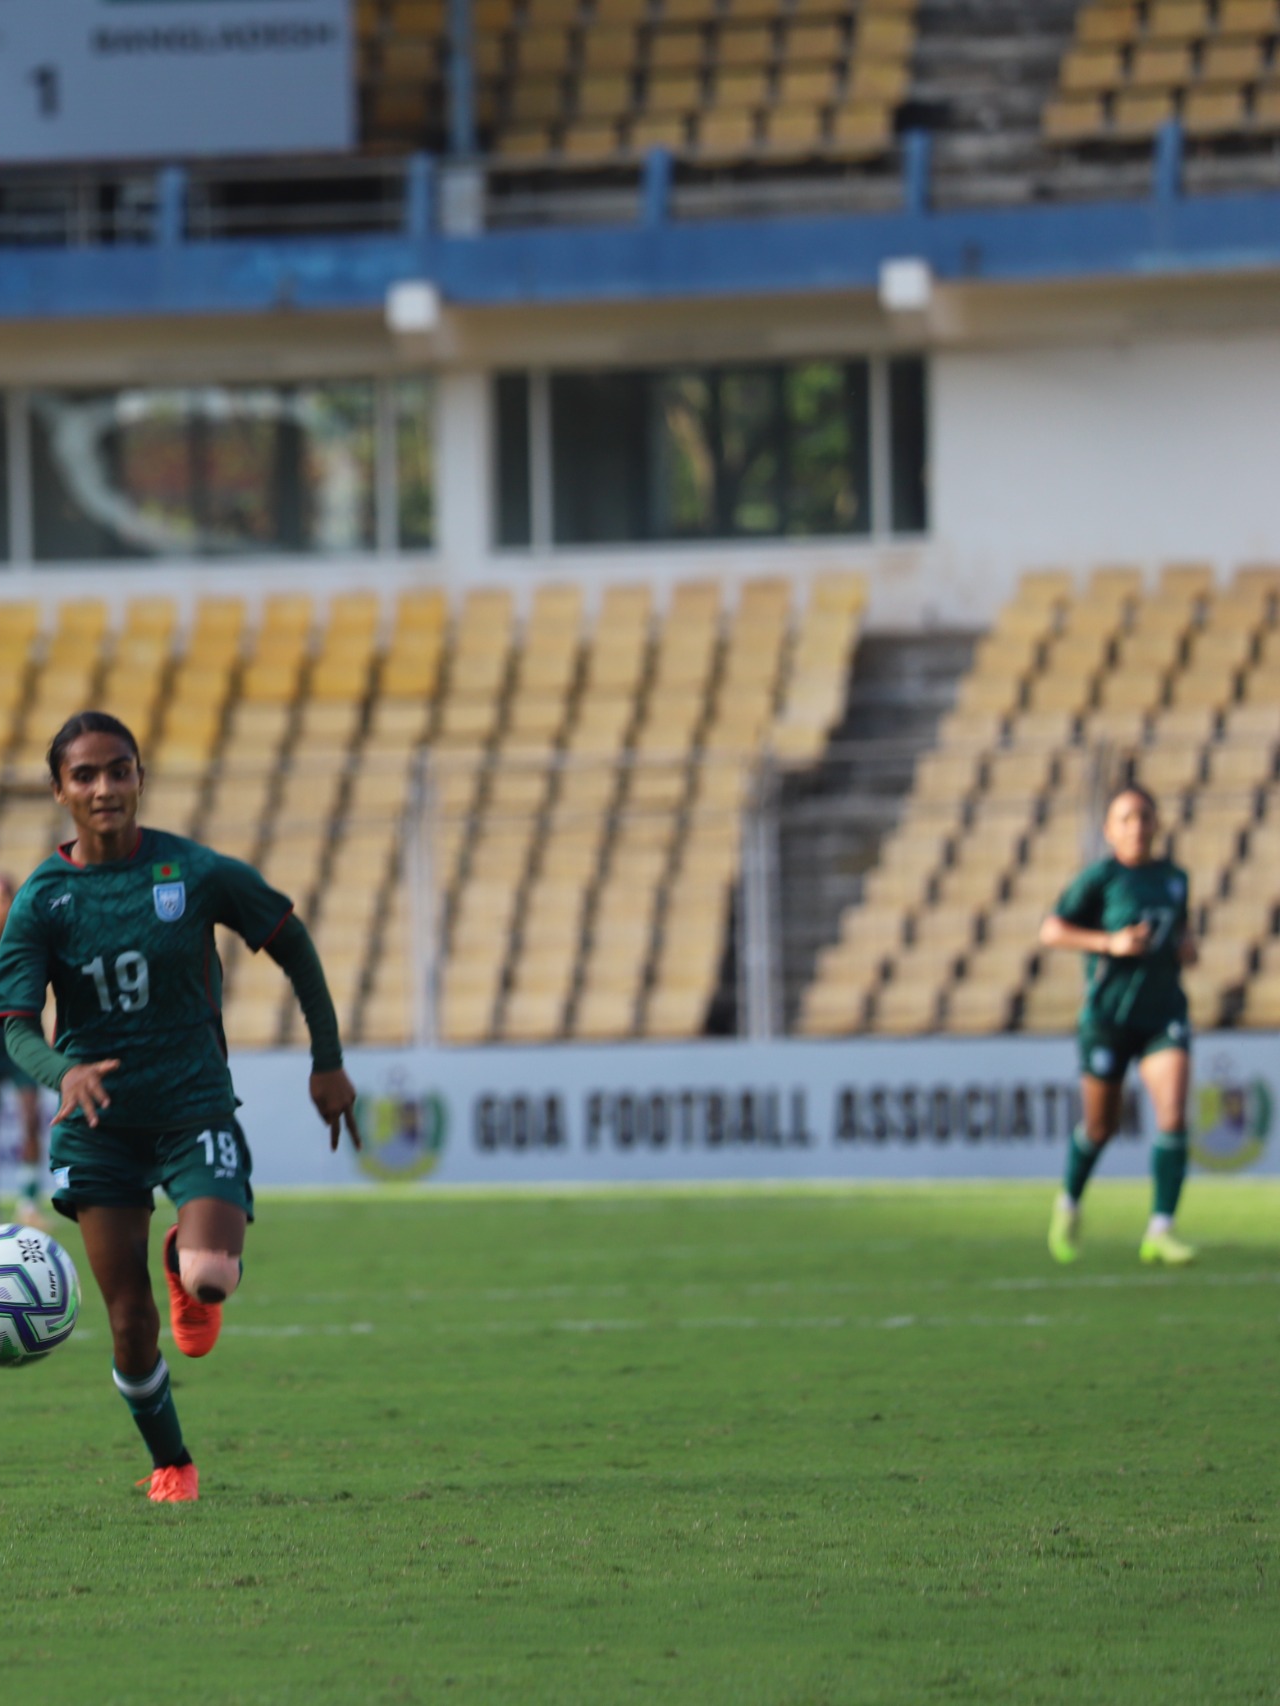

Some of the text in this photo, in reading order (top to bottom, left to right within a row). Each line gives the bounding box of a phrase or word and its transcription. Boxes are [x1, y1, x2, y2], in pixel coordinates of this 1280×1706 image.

[91, 22, 334, 55] BANGLADESH
[31, 64, 58, 117] 1
[81, 951, 150, 1013] 19
[475, 1091, 565, 1150] GOA
[587, 1087, 815, 1149] FOOTBALL
